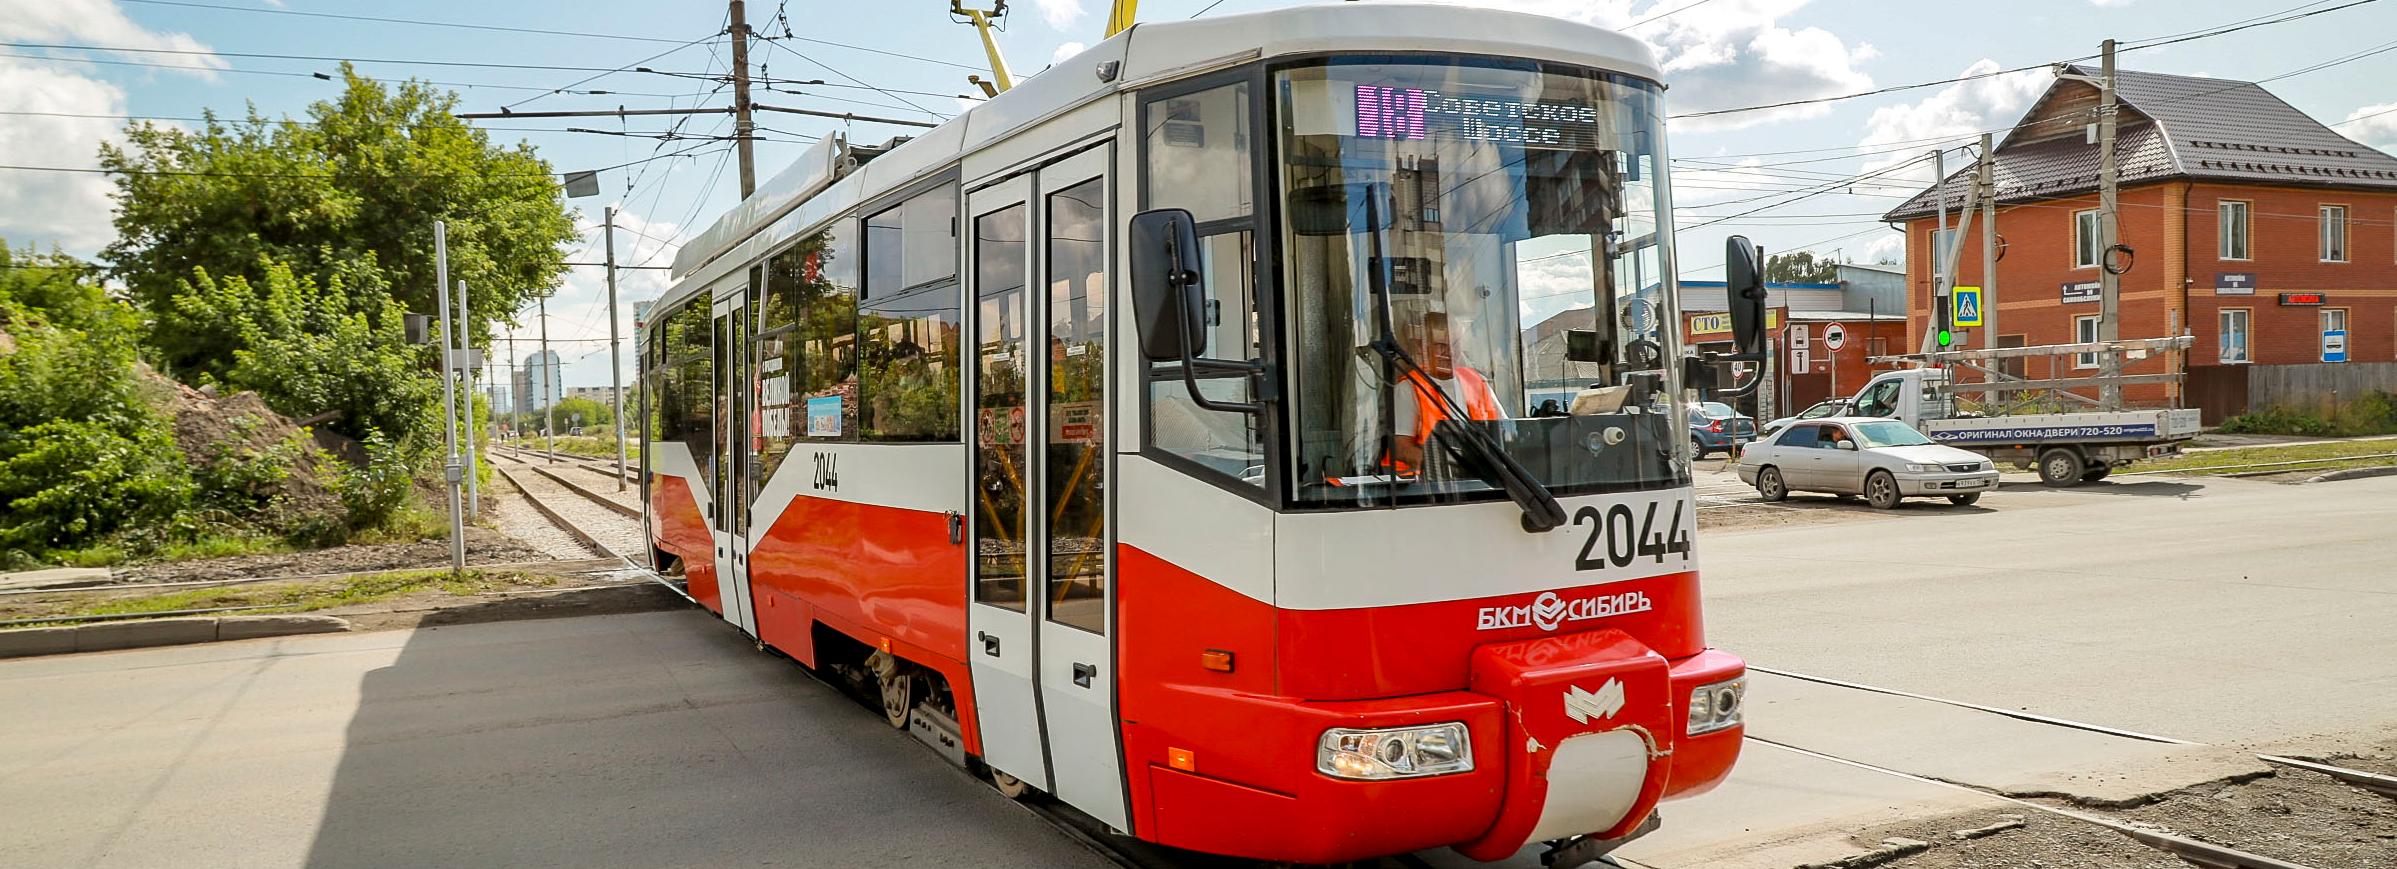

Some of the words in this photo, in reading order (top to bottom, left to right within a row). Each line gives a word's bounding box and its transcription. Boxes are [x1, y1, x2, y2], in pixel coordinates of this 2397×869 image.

[1423, 90, 1597, 123] Советское
[1463, 117, 1560, 144] Шоссе
[1693, 316, 1720, 332] СТО
[1733, 362, 1742, 374] 40
[1958, 430, 2012, 439] ОРИГИНАЛ
[2080, 426, 2122, 436] 720-520
[814, 451, 838, 493] 2044
[1573, 500, 1690, 571] 2044
[1477, 605, 1532, 630] БКМ
[1567, 591, 1652, 621] СИБИРЬ
